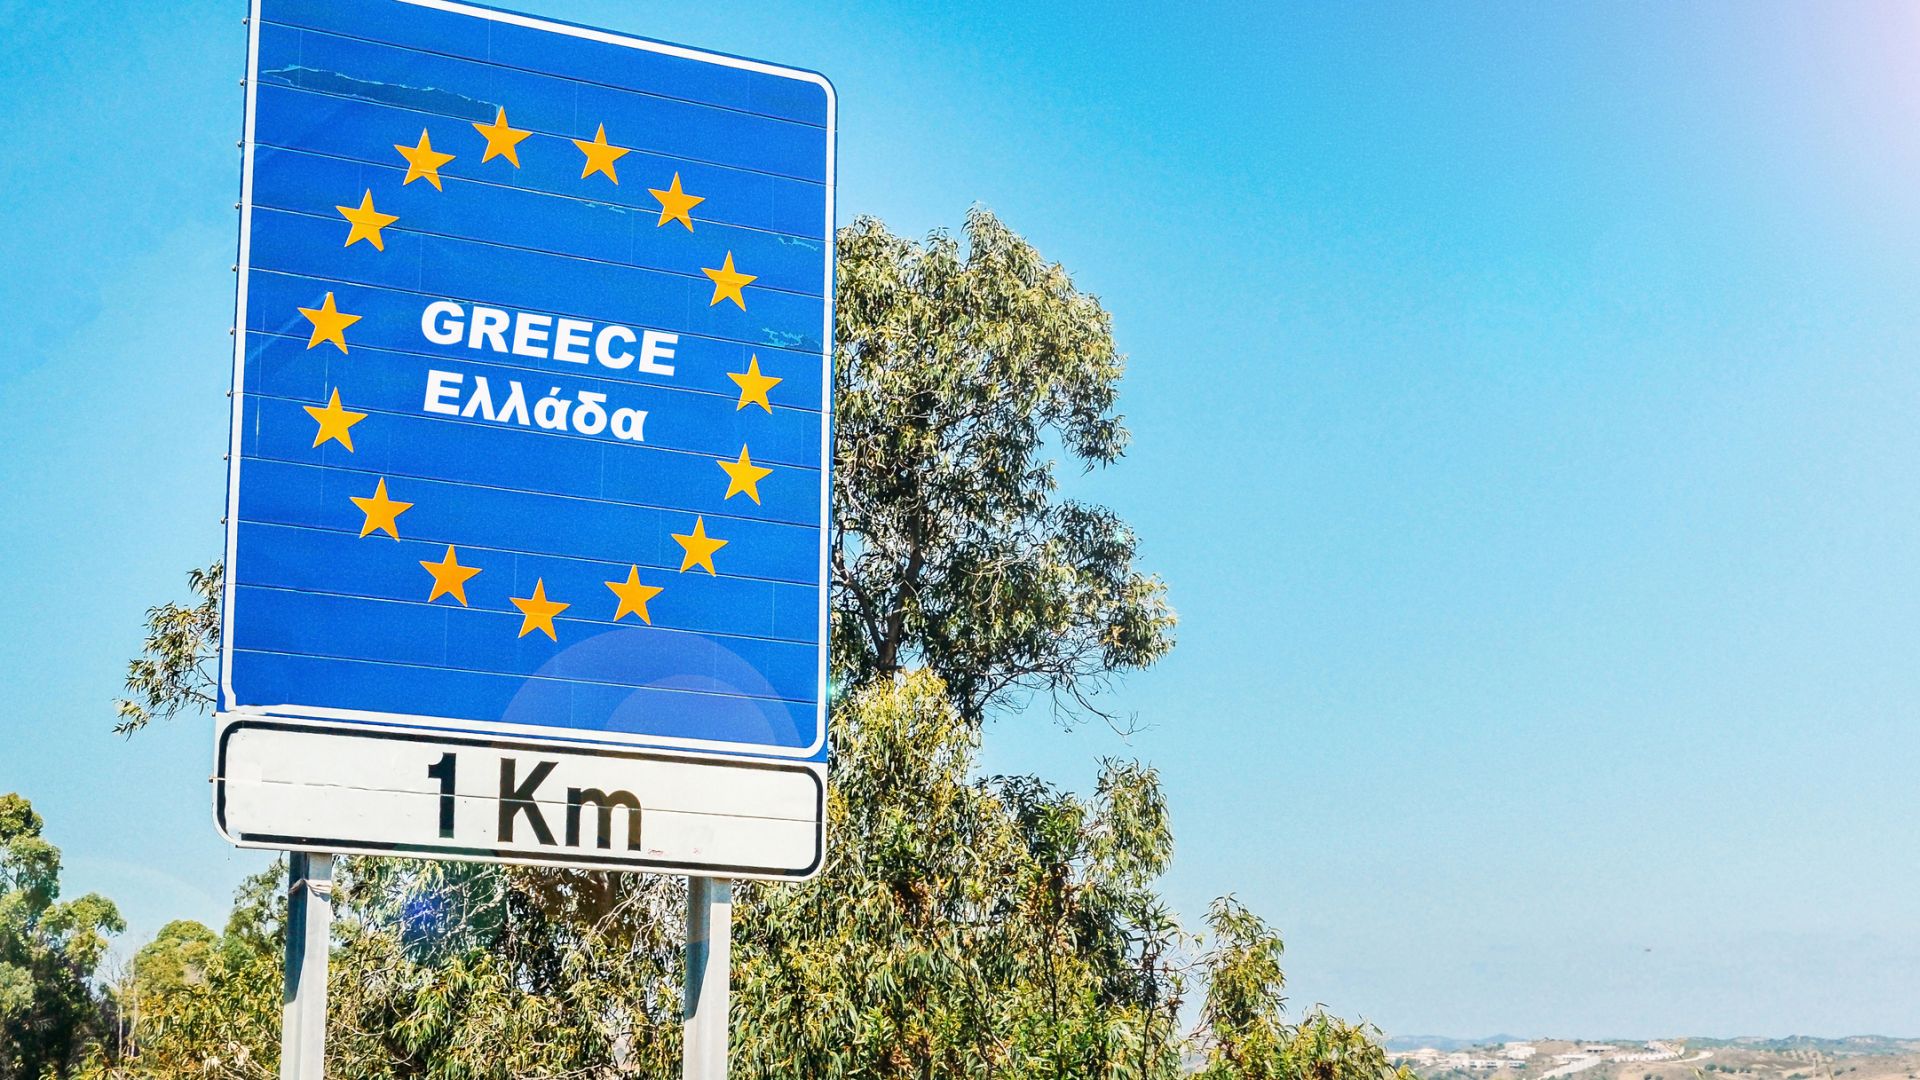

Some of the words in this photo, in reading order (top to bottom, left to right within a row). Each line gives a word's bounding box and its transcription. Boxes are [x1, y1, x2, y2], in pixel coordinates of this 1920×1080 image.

[421, 301, 679, 377] GREECE
[423, 369, 649, 442] Ελλάδα
[427, 752, 456, 839] 1
[498, 757, 642, 852] Km
